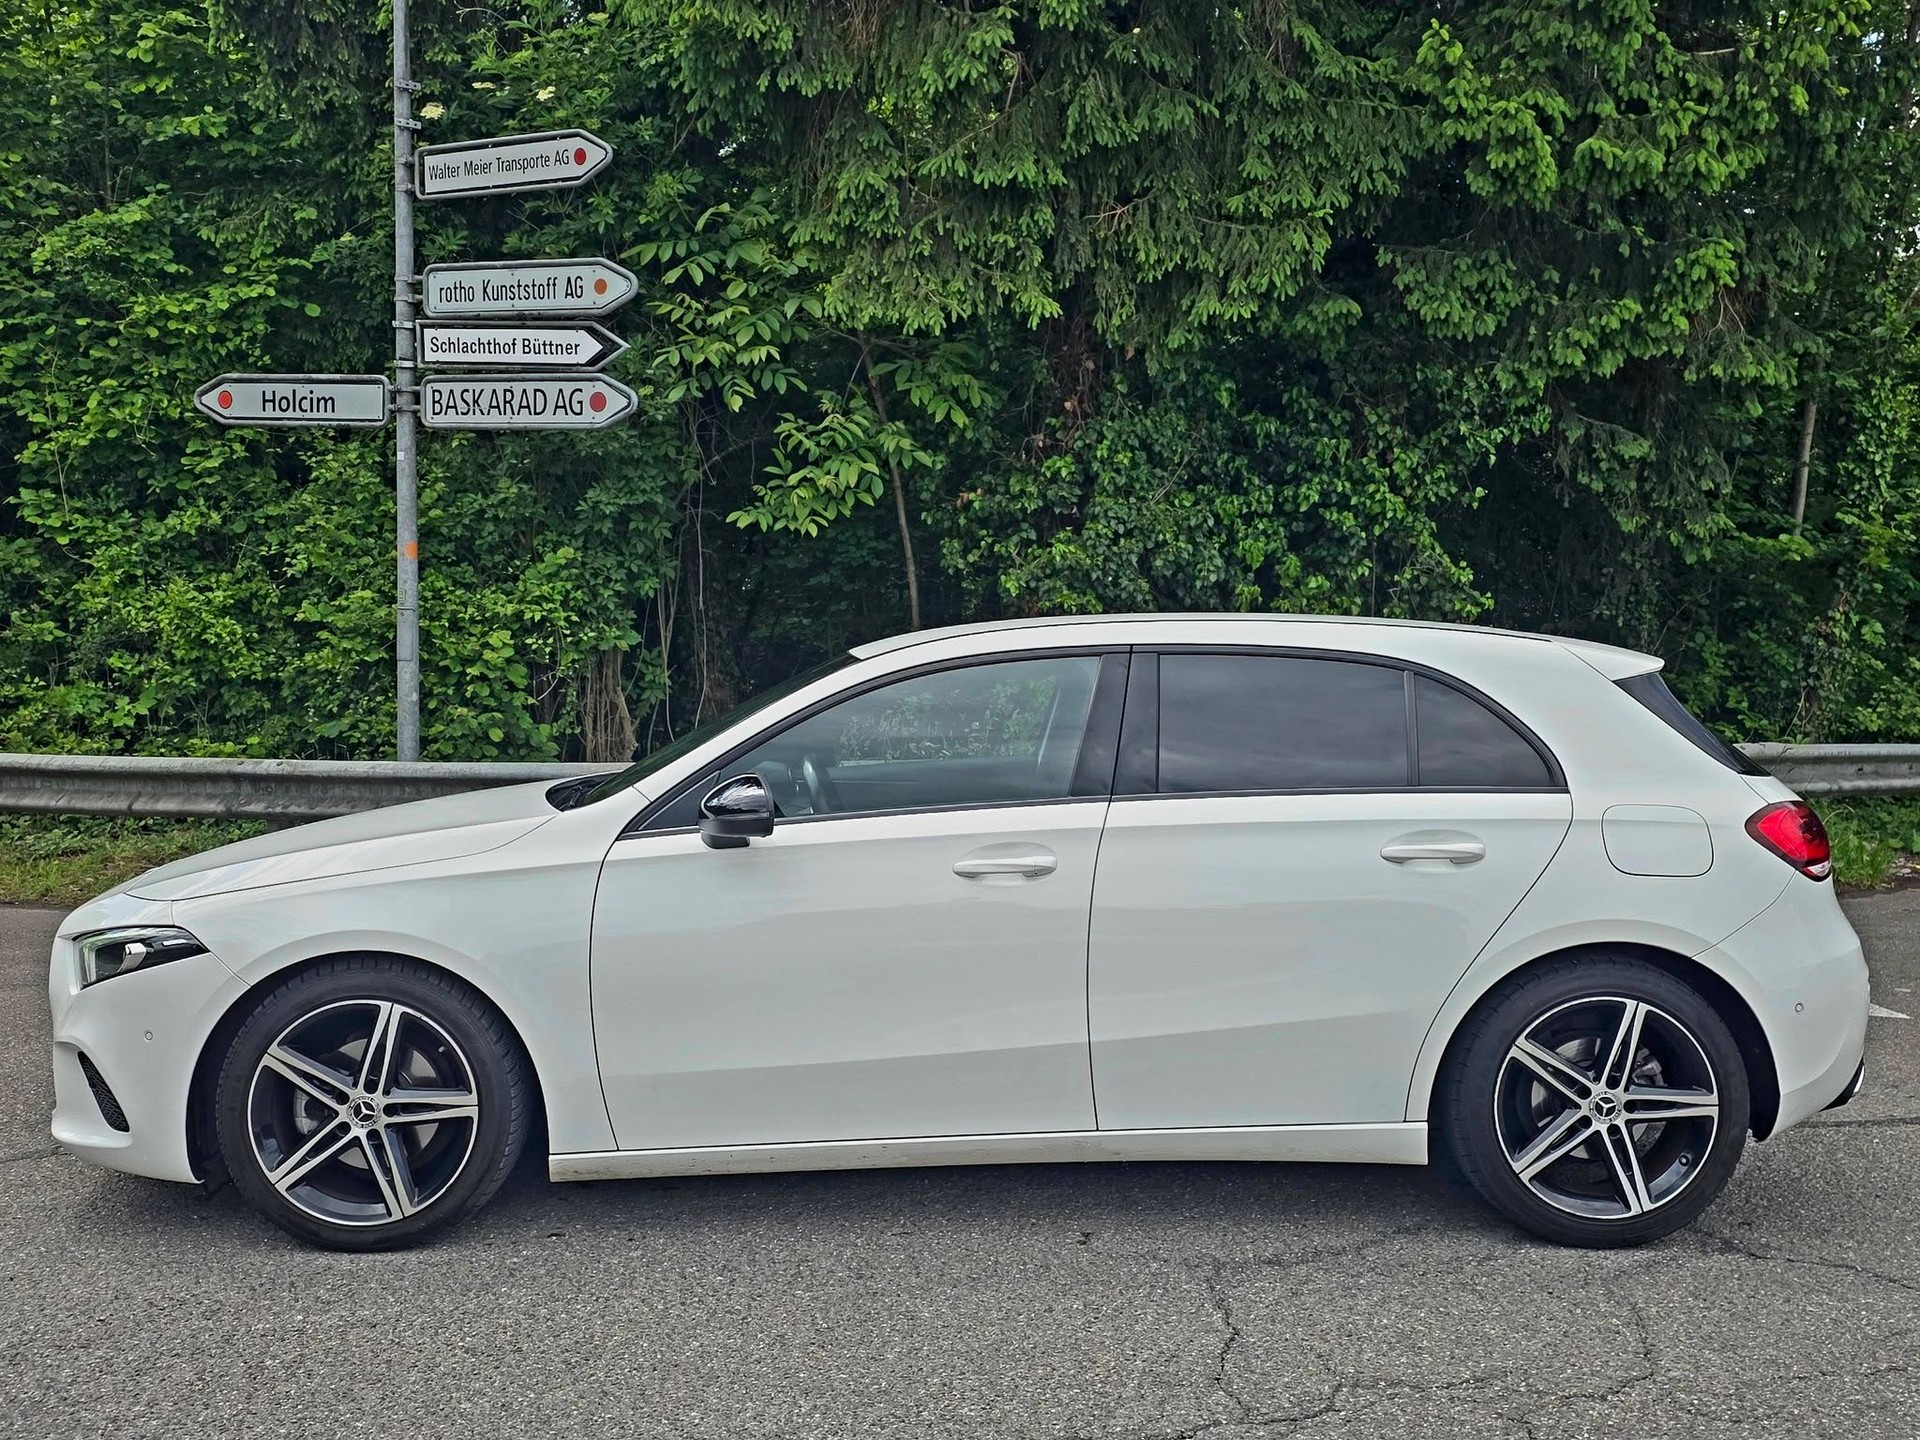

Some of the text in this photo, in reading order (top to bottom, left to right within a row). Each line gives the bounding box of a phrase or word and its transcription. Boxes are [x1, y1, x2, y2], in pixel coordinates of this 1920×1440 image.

[428, 149, 570, 180] Walter Meier Transporte AG
[439, 276, 584, 303] rotho Kunststoff AG
[430, 336, 580, 356] Schlachthof Büttner
[262, 389, 335, 413] Holcim
[431, 388, 584, 416] BASKARAD AG
